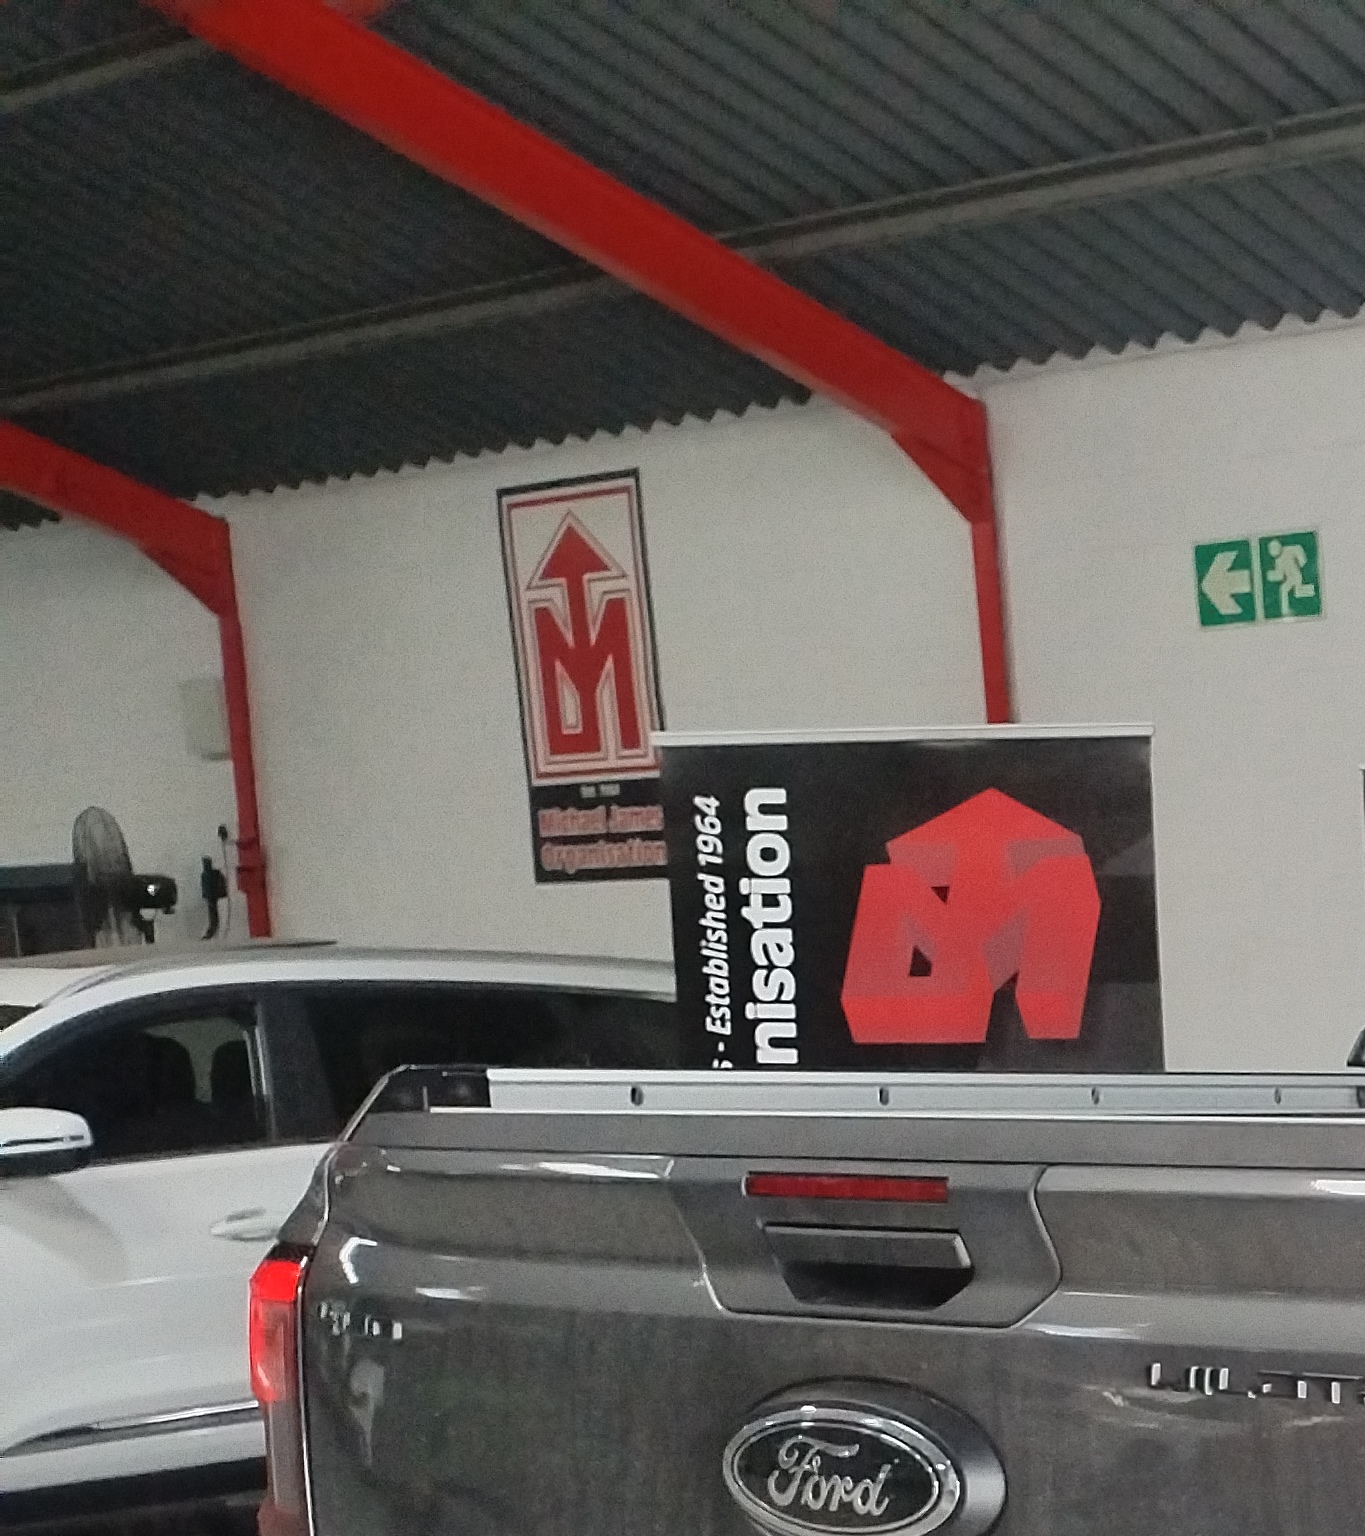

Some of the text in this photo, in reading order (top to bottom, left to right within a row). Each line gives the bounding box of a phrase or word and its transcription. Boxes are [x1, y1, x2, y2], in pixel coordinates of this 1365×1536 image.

[693, 794, 724, 866] 1964
[697, 872, 732, 1036] Established
[767, 1434, 892, 1517] Ford
